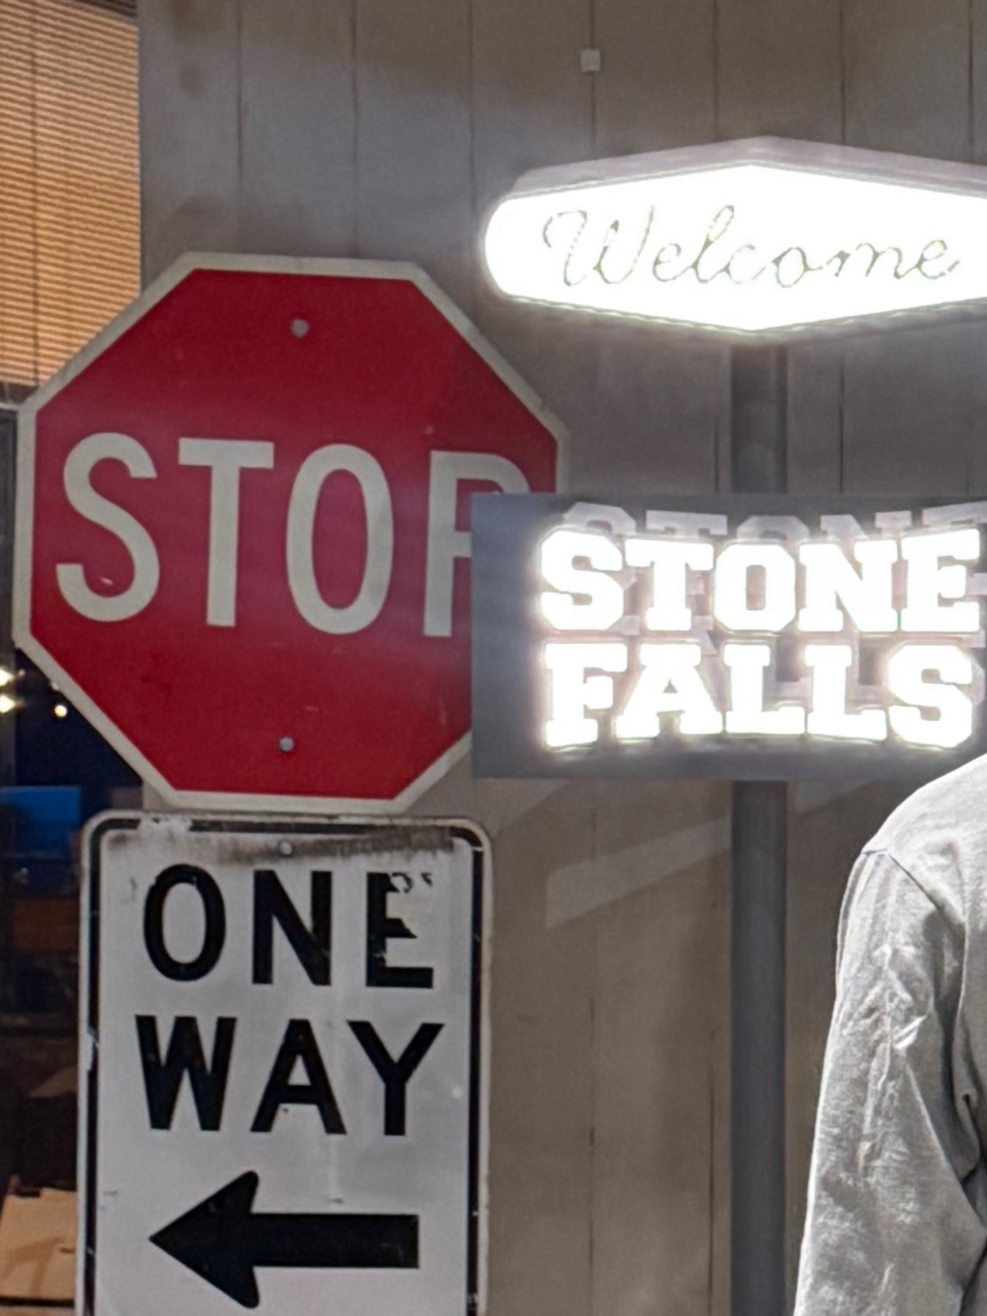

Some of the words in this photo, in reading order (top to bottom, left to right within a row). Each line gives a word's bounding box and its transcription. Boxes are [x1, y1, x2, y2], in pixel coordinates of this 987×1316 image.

[541, 203, 961, 289] Welcome
[538, 522, 984, 634] STONE
[542, 642, 980, 748] FALLS
[143, 864, 434, 989] ONE
[135, 1014, 445, 1136] WAY
